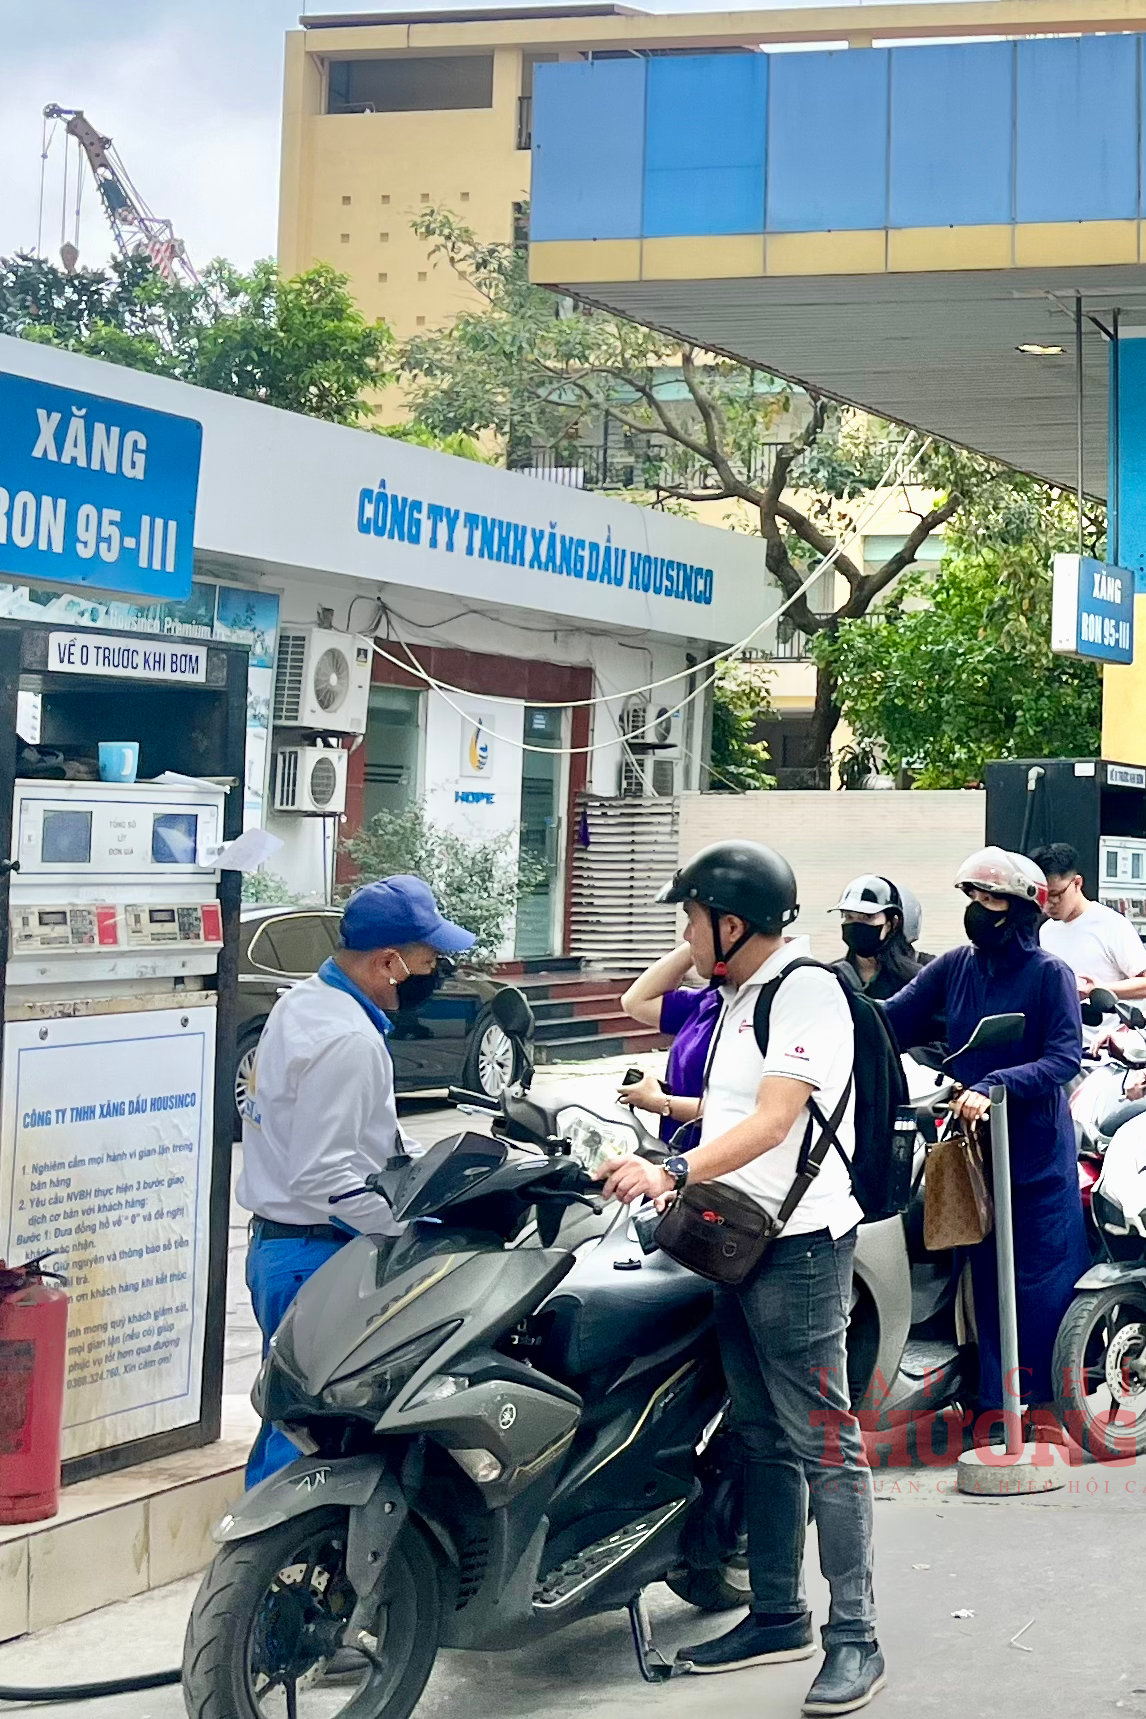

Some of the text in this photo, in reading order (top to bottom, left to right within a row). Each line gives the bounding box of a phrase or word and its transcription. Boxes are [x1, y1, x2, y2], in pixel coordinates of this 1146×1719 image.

[31, 405, 147, 480] XĂNG
[76, 503, 177, 573] 95-III
[357, 478, 714, 605] CÔNG TY TNHH XĂNG DẦU HOUSINCO
[1092, 569, 1122, 604] XĂNG
[1081, 611, 1130, 650] RON 95-III
[94, 644, 139, 670] TRƯỚC
[143, 650, 166, 673] KHI
[170, 652, 199, 674] BƠM
[22, 1108, 52, 1129] CÔNG
[55, 1107, 67, 1124] TY
[70, 1104, 97, 1123] TNHH
[98, 1099, 126, 1119] XĂNG
[149, 1092, 196, 1113] HOUSINCO
[66, 1188, 92, 1203] NVBH
